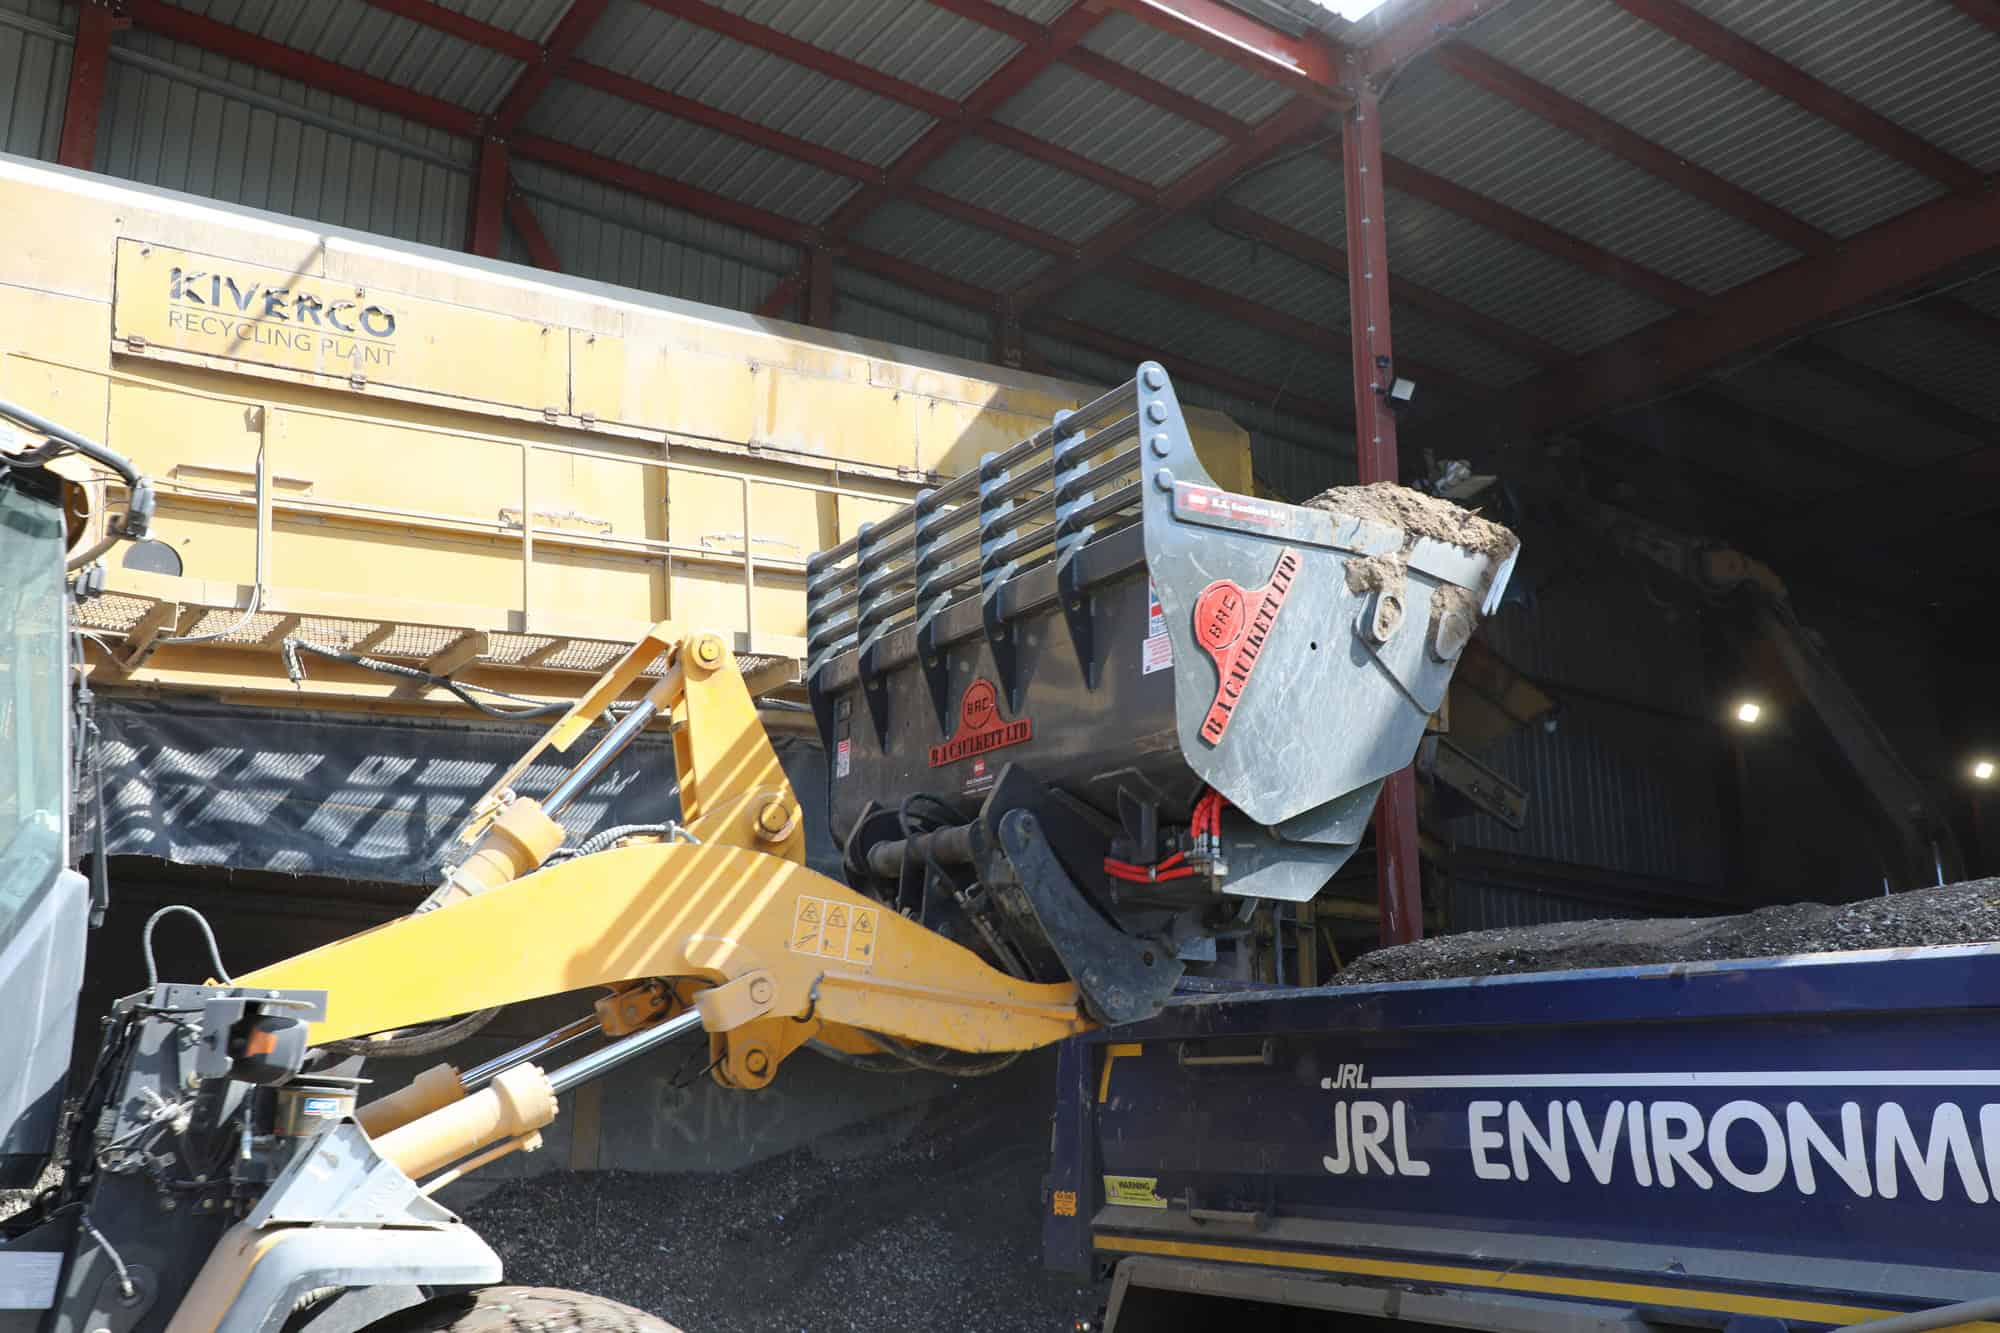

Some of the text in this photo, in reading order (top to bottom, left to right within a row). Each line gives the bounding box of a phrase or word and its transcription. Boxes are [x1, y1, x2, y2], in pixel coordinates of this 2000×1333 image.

[169, 267, 396, 338] KIVERCO
[169, 310, 395, 366] RECYCLING PLANT
[1272, 555, 1297, 595] LTD
[1007, 721, 1028, 742] LTD
[1331, 1063, 1369, 1089] JRL
[1322, 1100, 1431, 1177] JRL
[1118, 1181, 1151, 1191] WARNING
